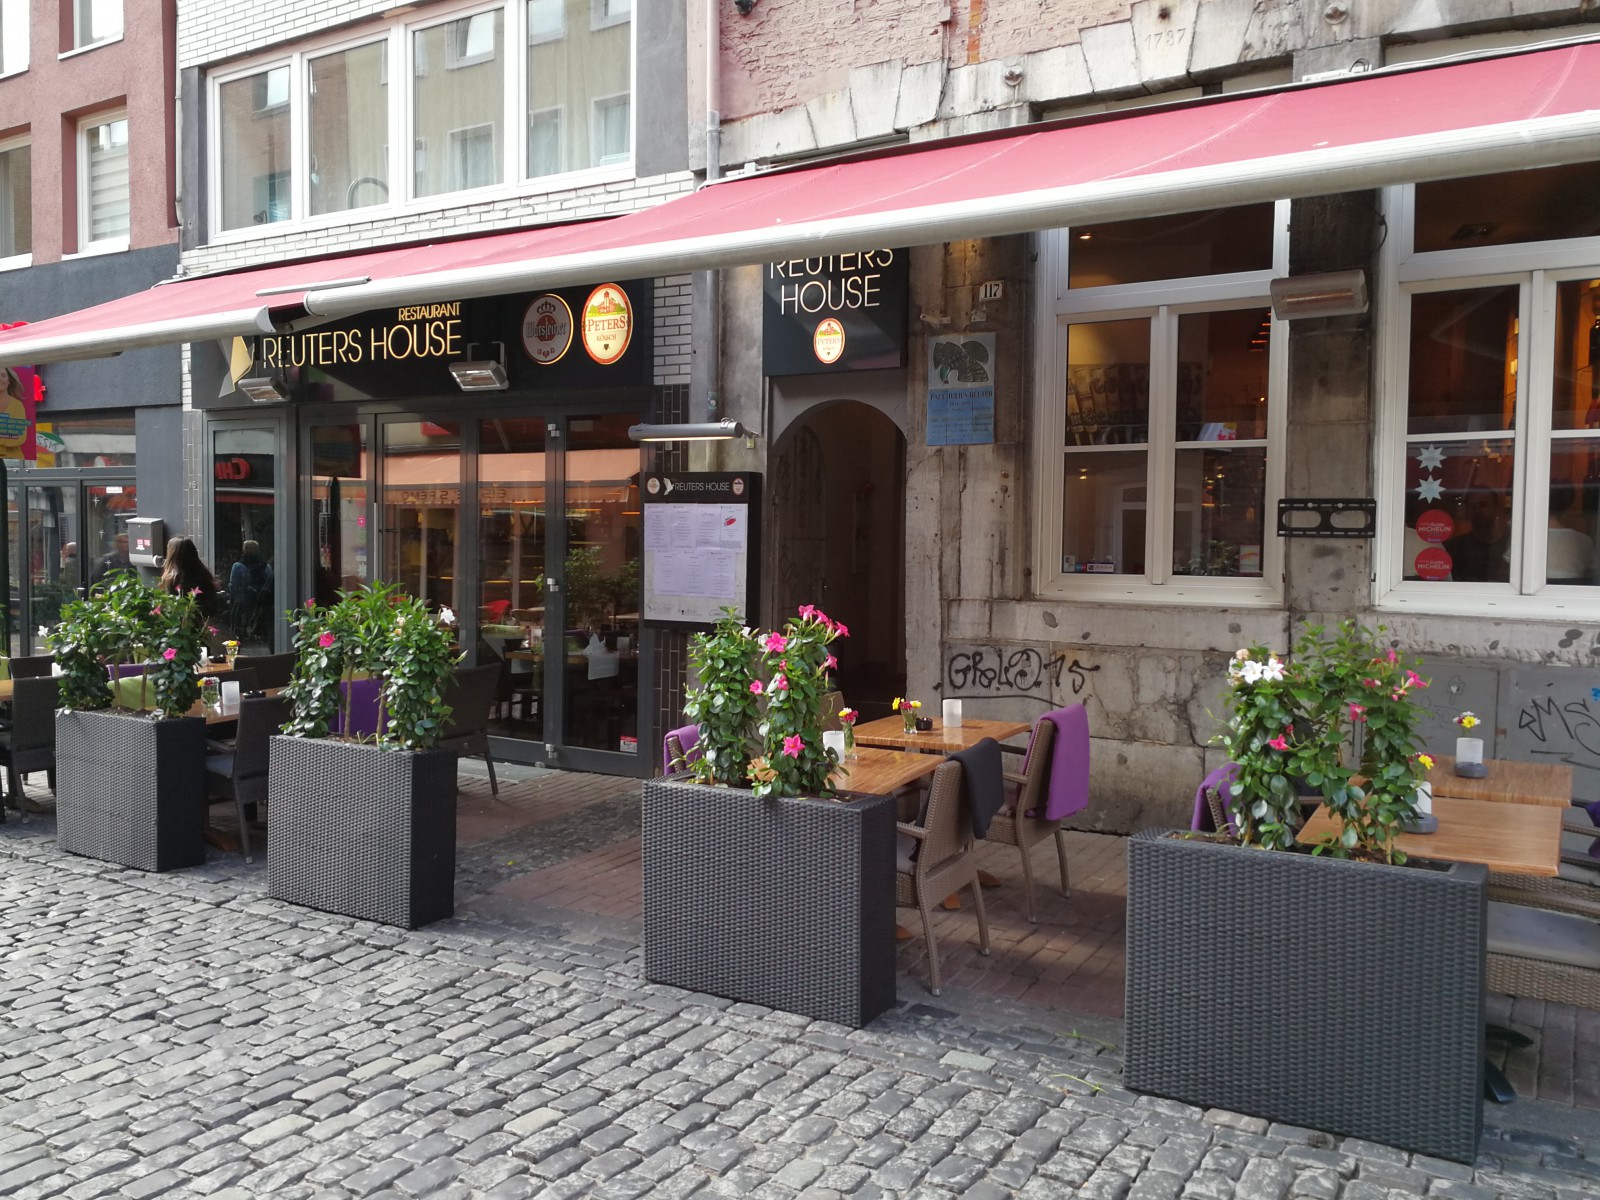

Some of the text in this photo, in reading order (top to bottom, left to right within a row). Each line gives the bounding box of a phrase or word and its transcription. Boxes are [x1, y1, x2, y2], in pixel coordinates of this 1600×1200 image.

[781, 273, 881, 315] HOUSE
[983, 283, 1000, 298] 117
[398, 301, 460, 322] RESTAURANT
[587, 316, 626, 332] PETERS
[262, 320, 461, 368] REUTERS HOUSE
[674, 482, 730, 491] REUTERS HOUSE
